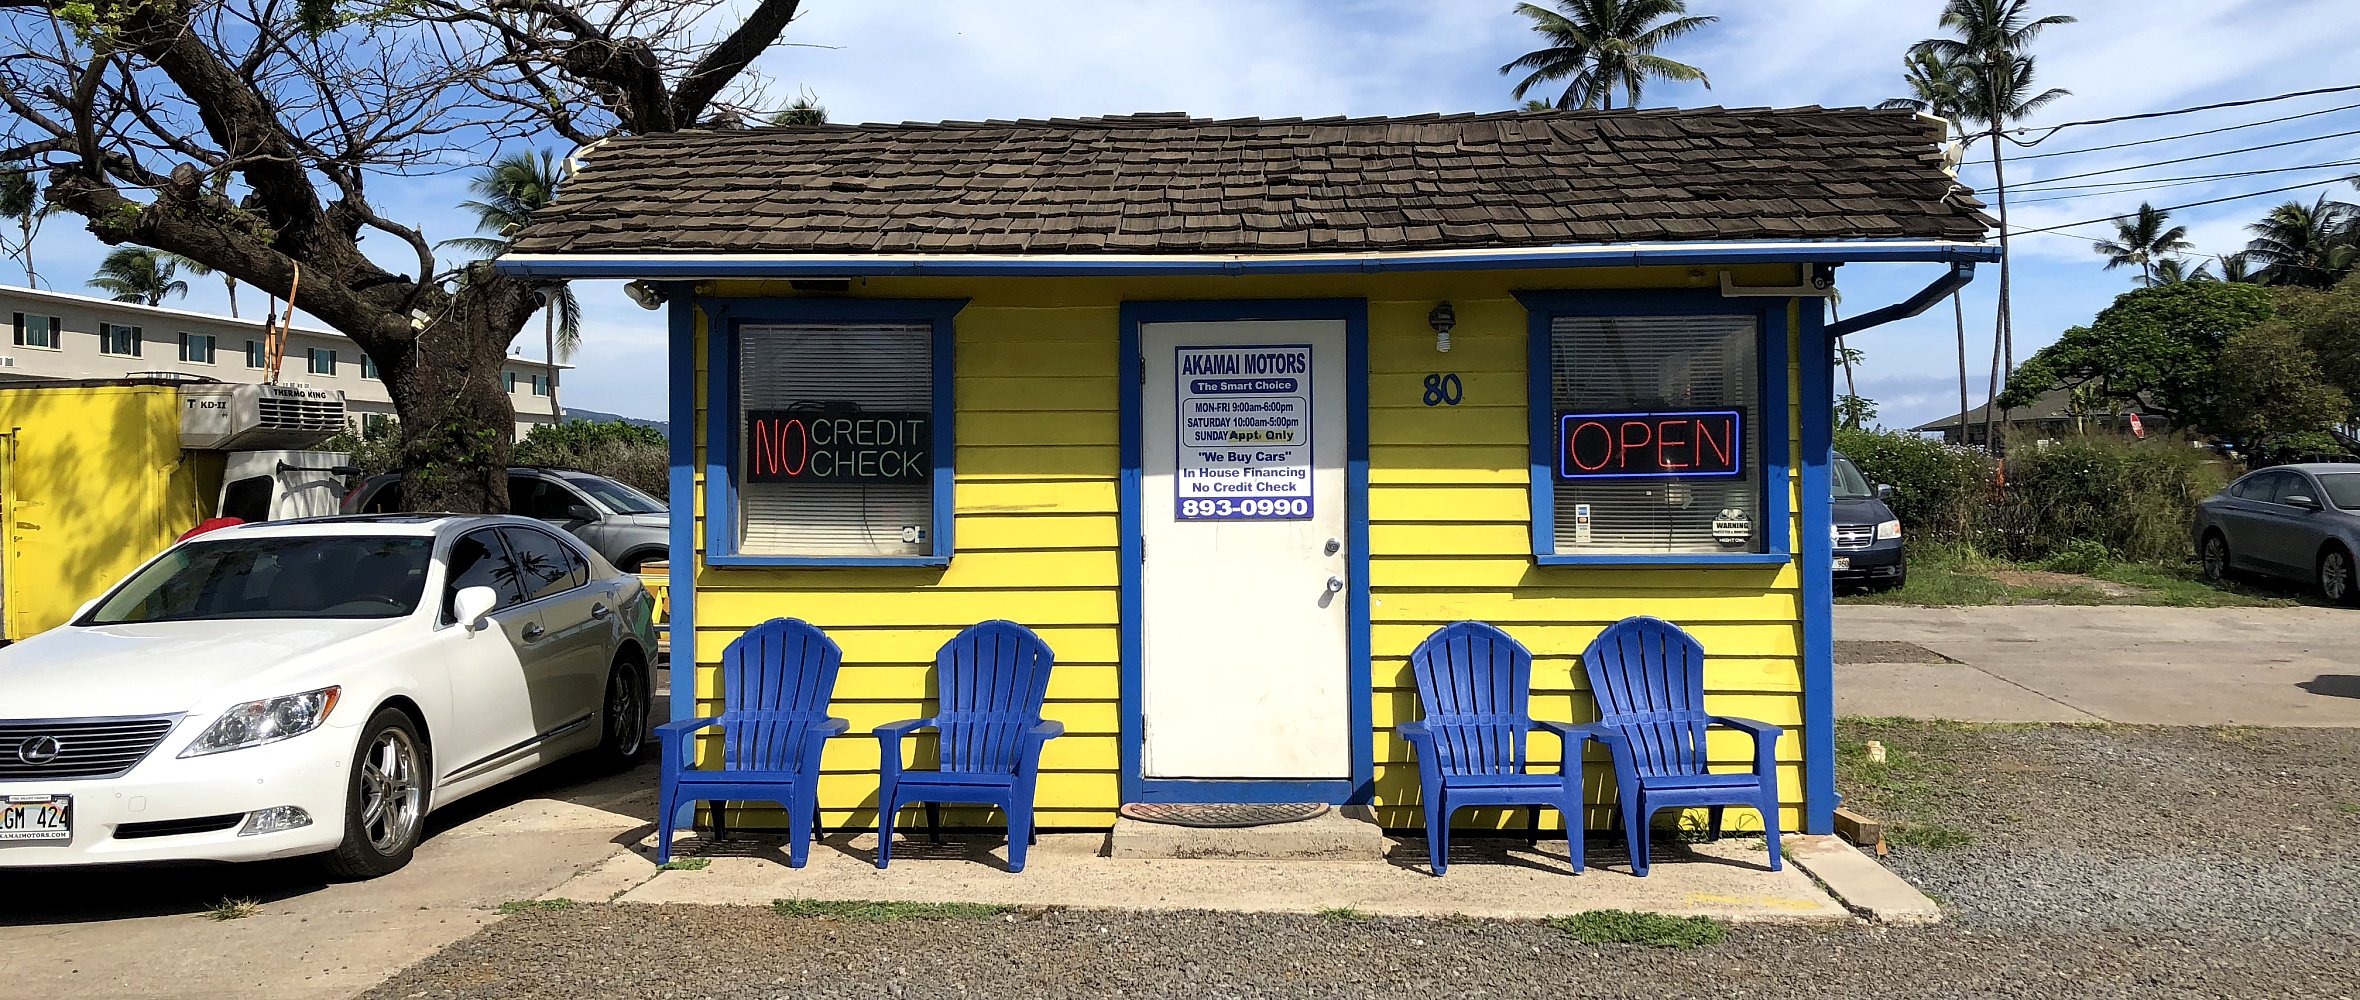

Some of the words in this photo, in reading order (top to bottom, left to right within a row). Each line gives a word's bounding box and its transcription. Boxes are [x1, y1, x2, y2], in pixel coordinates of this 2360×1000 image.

[1182, 353, 1240, 375] AKAMAI
[1244, 352, 1306, 374] MOTORS
[1197, 382, 1218, 391] The
[1220, 381, 1252, 391] Smart
[1255, 381, 1291, 390] Choice
[1422, 372, 1463, 407] 80
[273, 388, 306, 398] THERMO
[307, 391, 327, 399] KING
[1195, 402, 1231, 413] MON-FRI
[1232, 401, 1294, 414] 9:00am-6:00pm
[1187, 417, 1231, 428] SATURDAY
[1233, 416, 1299, 428] 10:00am-5:00pm
[1194, 431, 1228, 441] SUNDAY
[1265, 430, 1294, 441] Only
[756, 418, 807, 476] NO
[811, 418, 925, 446] CREDIT
[1571, 419, 1730, 471] OPEN
[811, 450, 925, 478] CHECK
[1198, 451, 1224, 462] "We
[1227, 451, 1252, 464] Buy
[1255, 451, 1292, 462] Cars"
[1183, 467, 1196, 478] In
[1199, 467, 1240, 478] House
[1243, 466, 1306, 479] Financing
[1192, 482, 1210, 493] No
[1213, 482, 1253, 492] Credit
[1256, 481, 1297, 492] Check
[1182, 498, 1308, 517] 893-0990
[0, 806, 25, 830] GM
[37, 805, 69, 828] 424
